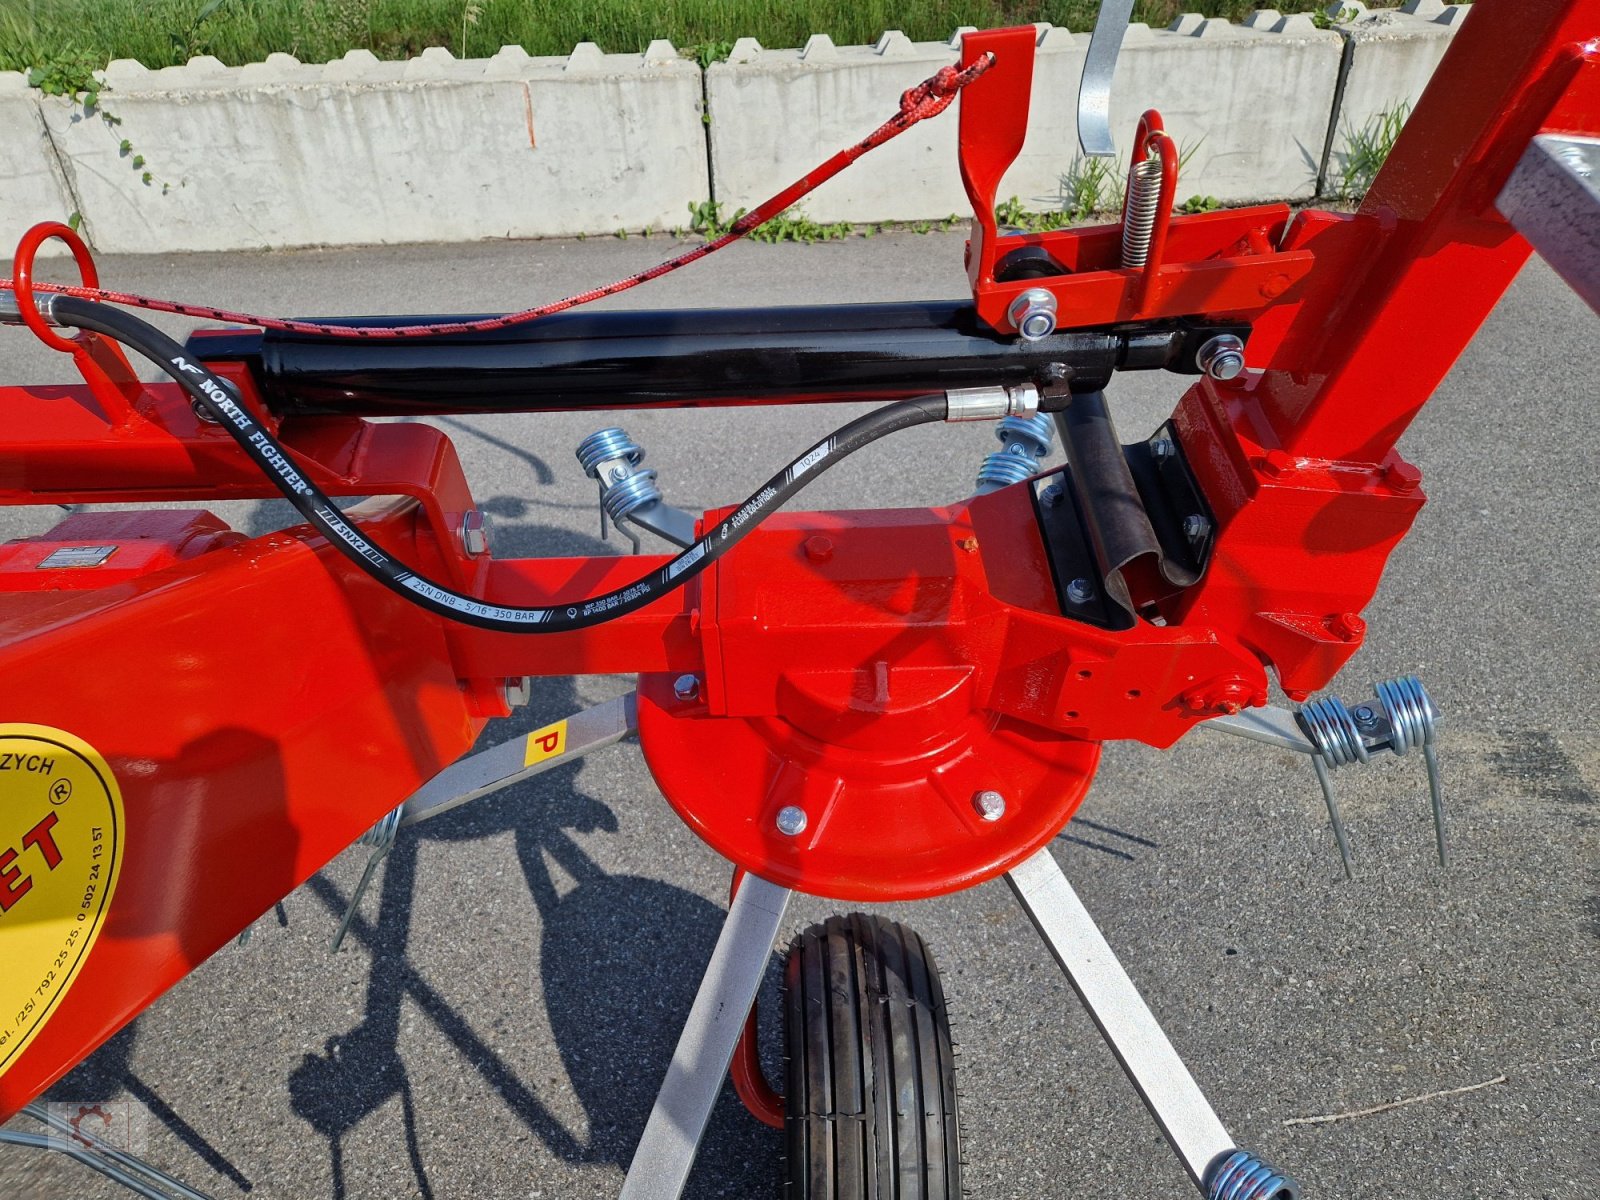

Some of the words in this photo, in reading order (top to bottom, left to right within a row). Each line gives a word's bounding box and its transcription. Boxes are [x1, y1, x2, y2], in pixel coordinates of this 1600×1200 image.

[199, 378, 253, 430] NORTH
[731, 499, 756, 521] FLEXIBLE
[756, 486, 772, 500] HOSE
[733, 514, 749, 528] FLUID
[748, 488, 777, 515] SOLUTIONS
[337, 521, 366, 550] SNX2
[434, 591, 456, 605] DN8
[493, 609, 512, 619] 350
[514, 612, 535, 621] BAR
[606, 595, 618, 603] BAR
[607, 601, 619, 609] BAR
[534, 731, 559, 752] P
[92, 827, 102, 841] 57
[92, 844, 102, 860] 13
[89, 863, 101, 881] 24
[81, 884, 96, 909] 502
[77, 913, 86, 921] 0
[54, 950, 68, 968] 25
[35, 970, 56, 996] 792
